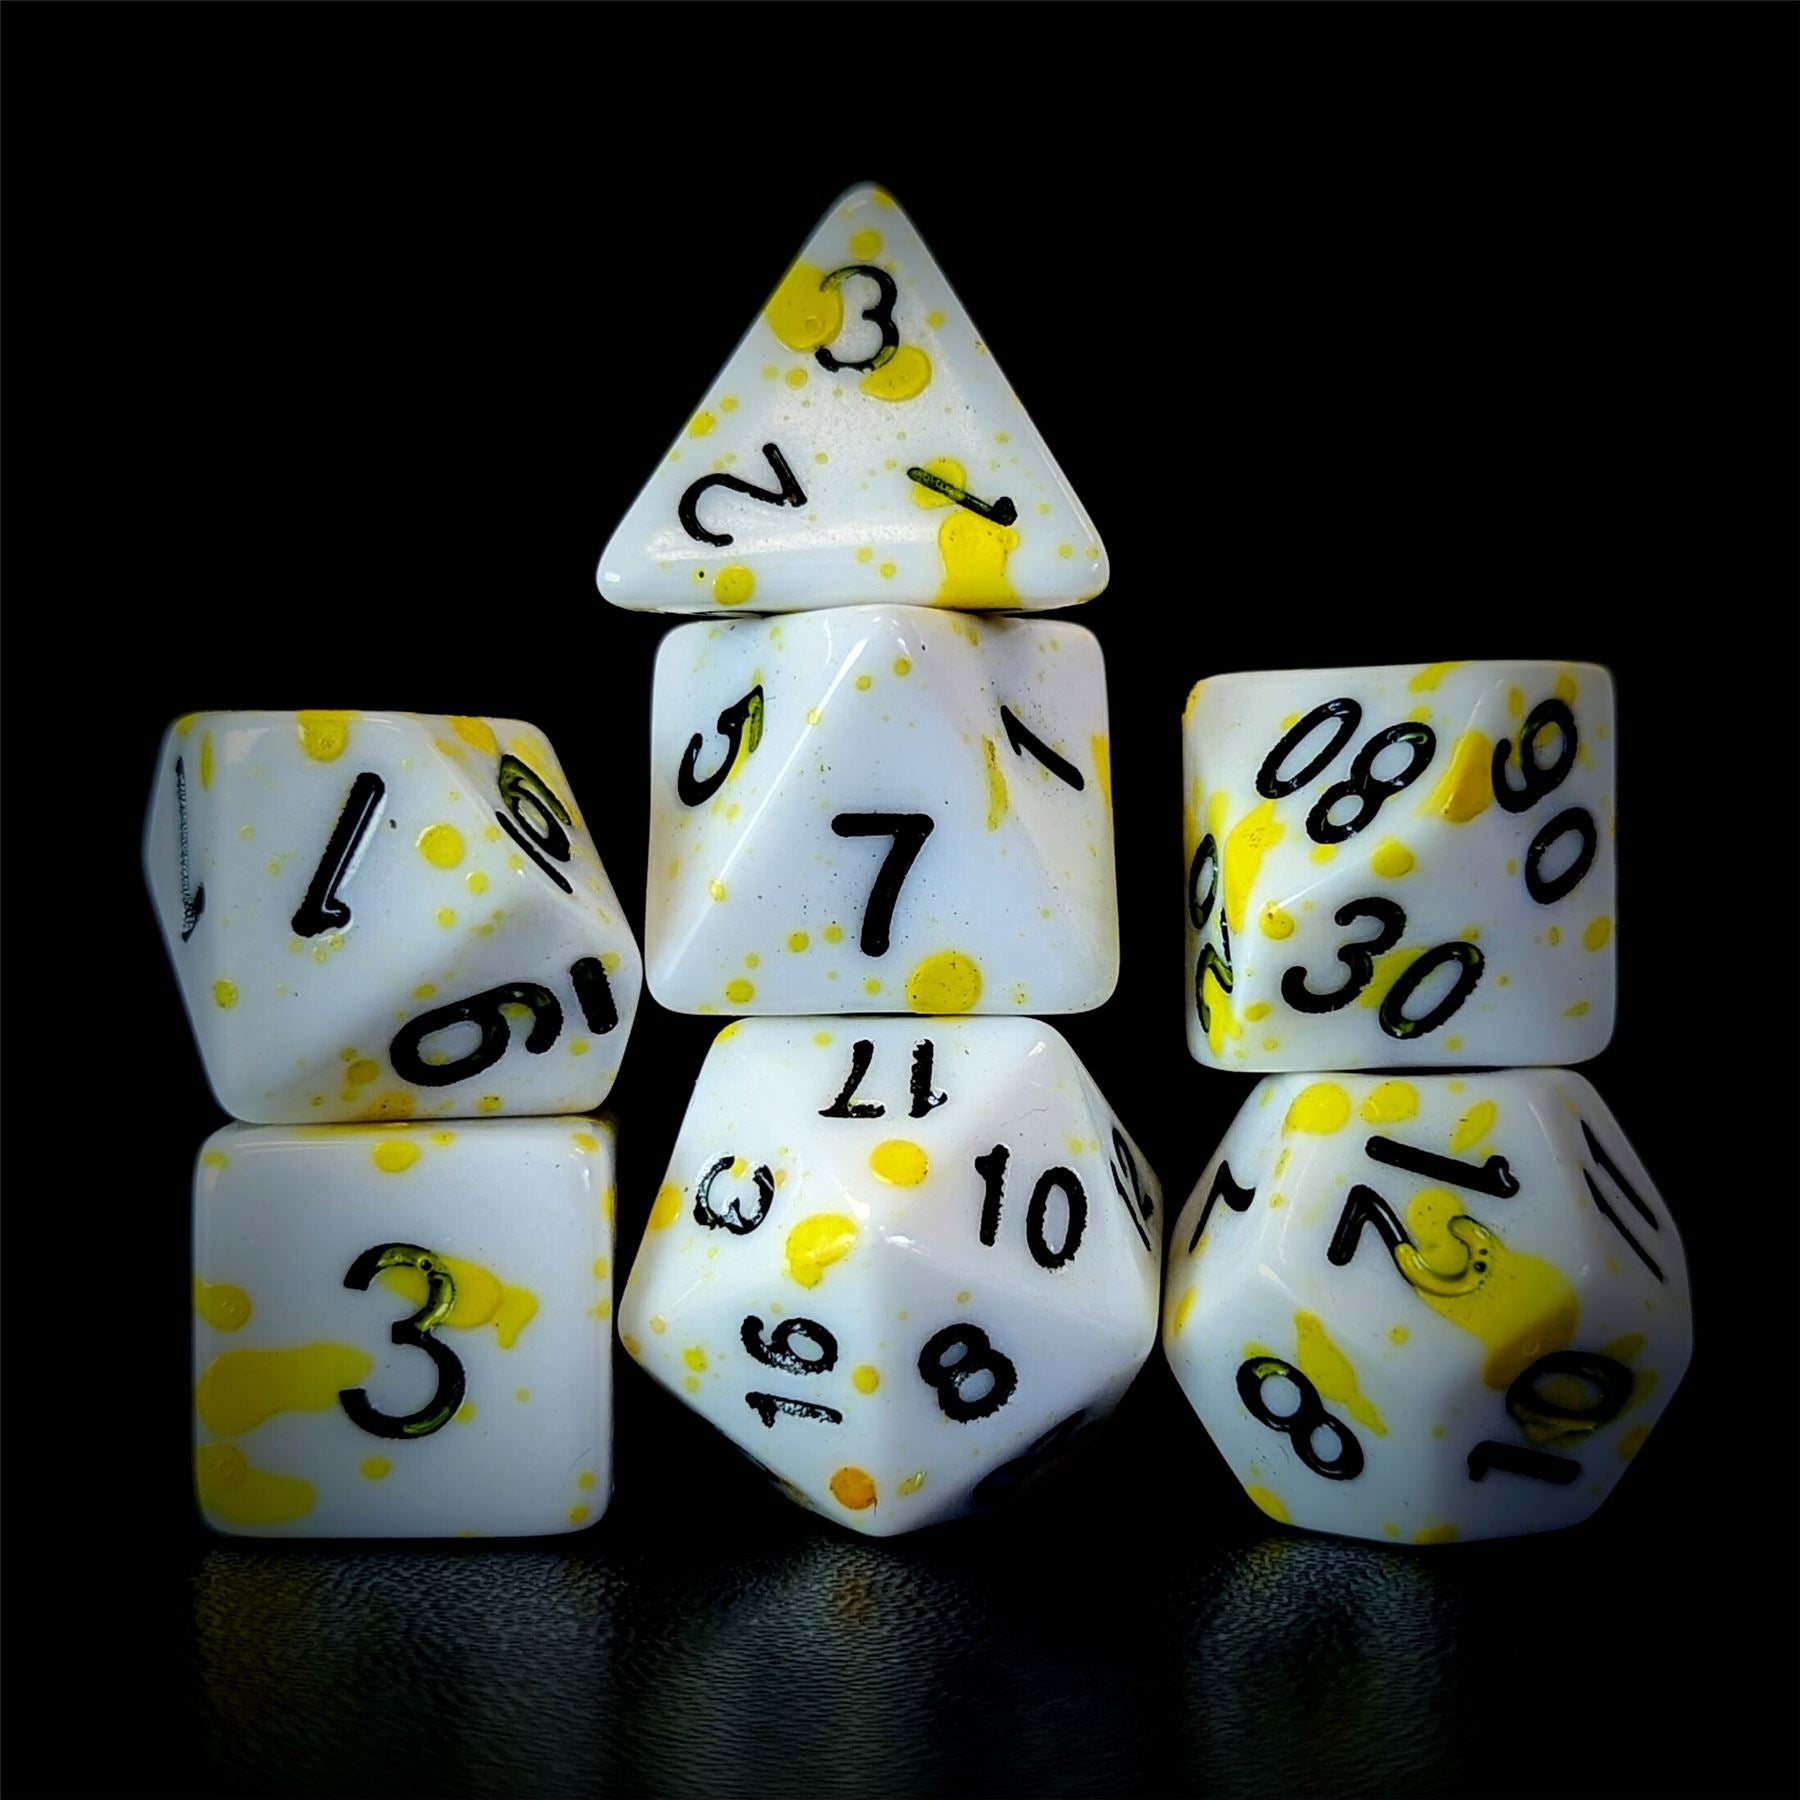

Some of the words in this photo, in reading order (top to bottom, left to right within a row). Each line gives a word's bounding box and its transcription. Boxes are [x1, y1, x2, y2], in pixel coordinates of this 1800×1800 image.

[814, 263, 900, 373] 3
[678, 442, 807, 547] 2
[907, 467, 1017, 527] 1
[677, 684, 764, 808] 5
[1000, 704, 1085, 791] 1
[1256, 698, 1437, 844] 80
[1491, 698, 1598, 905] 90
[291, 772, 385, 937] 1
[831, 813, 934, 957] 7
[1281, 897, 1485, 1040] 30
[818, 1039, 949, 1118] 17
[693, 1155, 775, 1235] 3
[974, 1144, 1088, 1270] 10
[1328, 1135, 1520, 1298] 12
[1580, 1119, 1664, 1283] 11
[338, 1242, 466, 1440] 3
[740, 1315, 843, 1428] 16
[917, 1322, 1018, 1424] 8
[1236, 1356, 1364, 1480] 8
[1466, 1350, 1633, 1484] 10
